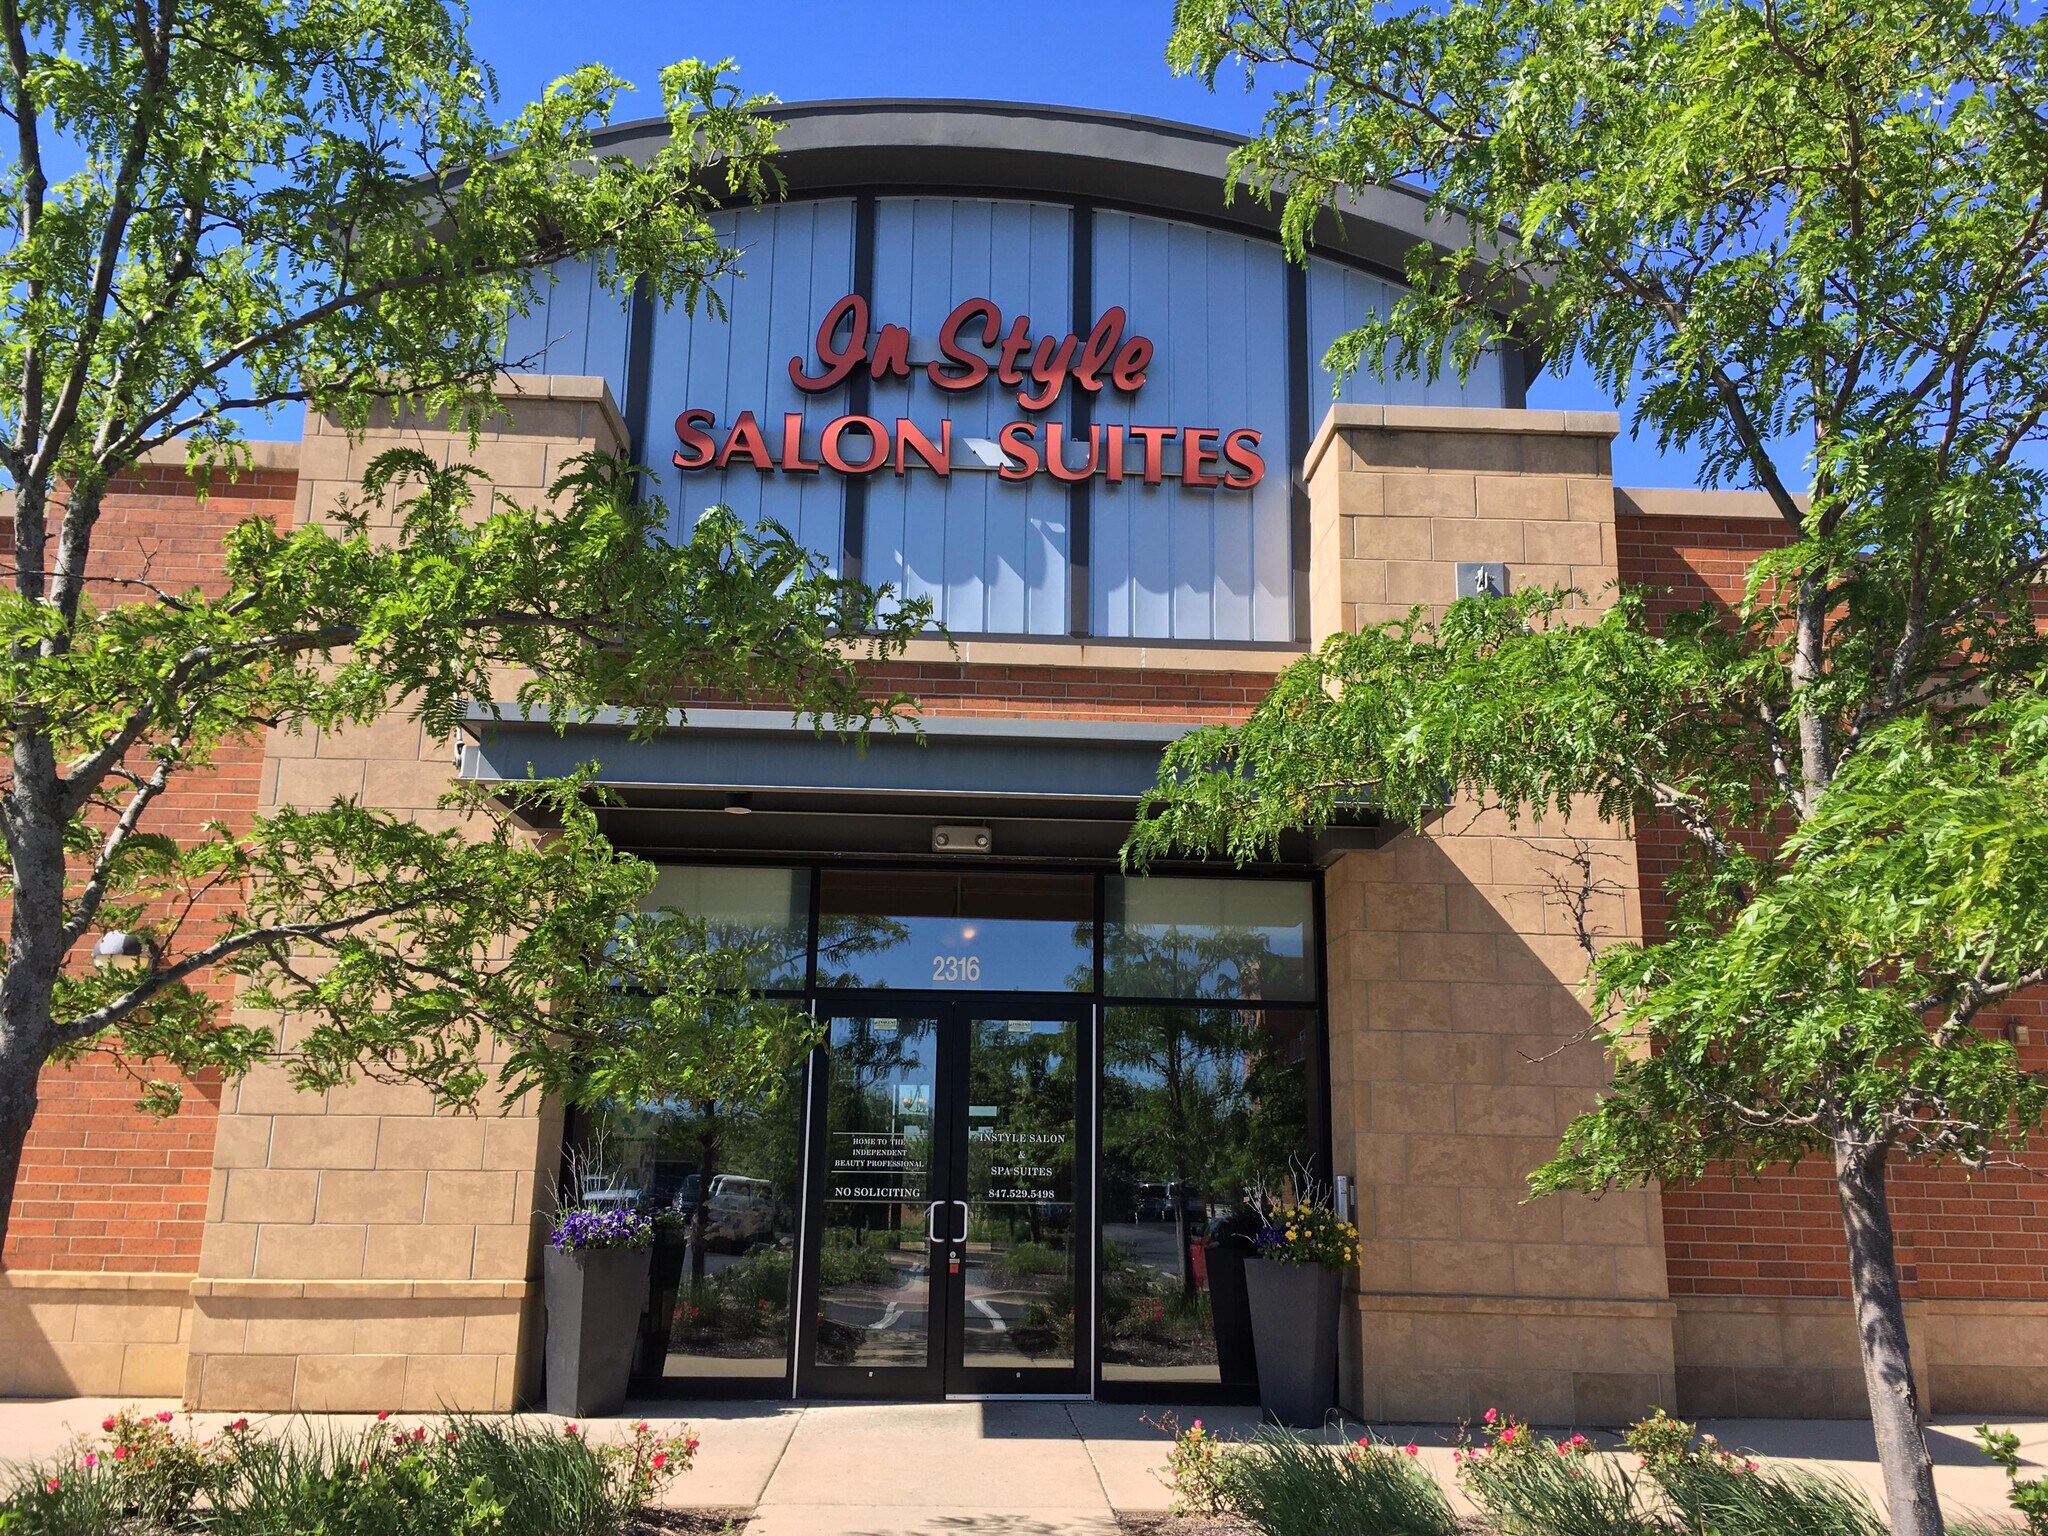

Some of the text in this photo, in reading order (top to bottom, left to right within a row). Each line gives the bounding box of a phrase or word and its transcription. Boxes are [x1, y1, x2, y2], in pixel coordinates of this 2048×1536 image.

[788, 293, 1154, 412] In Style
[672, 408, 1267, 490] SALON SUITES
[932, 956, 980, 982] 2316
[980, 1133, 1065, 1143] INSTYLE SALON
[1018, 1151, 1026, 1159] &
[866, 1160, 925, 1168] PROFESSIONAL
[991, 1166, 1053, 1176] SPA SUITES
[835, 1187, 920, 1197] NO SOLICITING
[988, 1189, 1055, 1199] 847.529.5498
